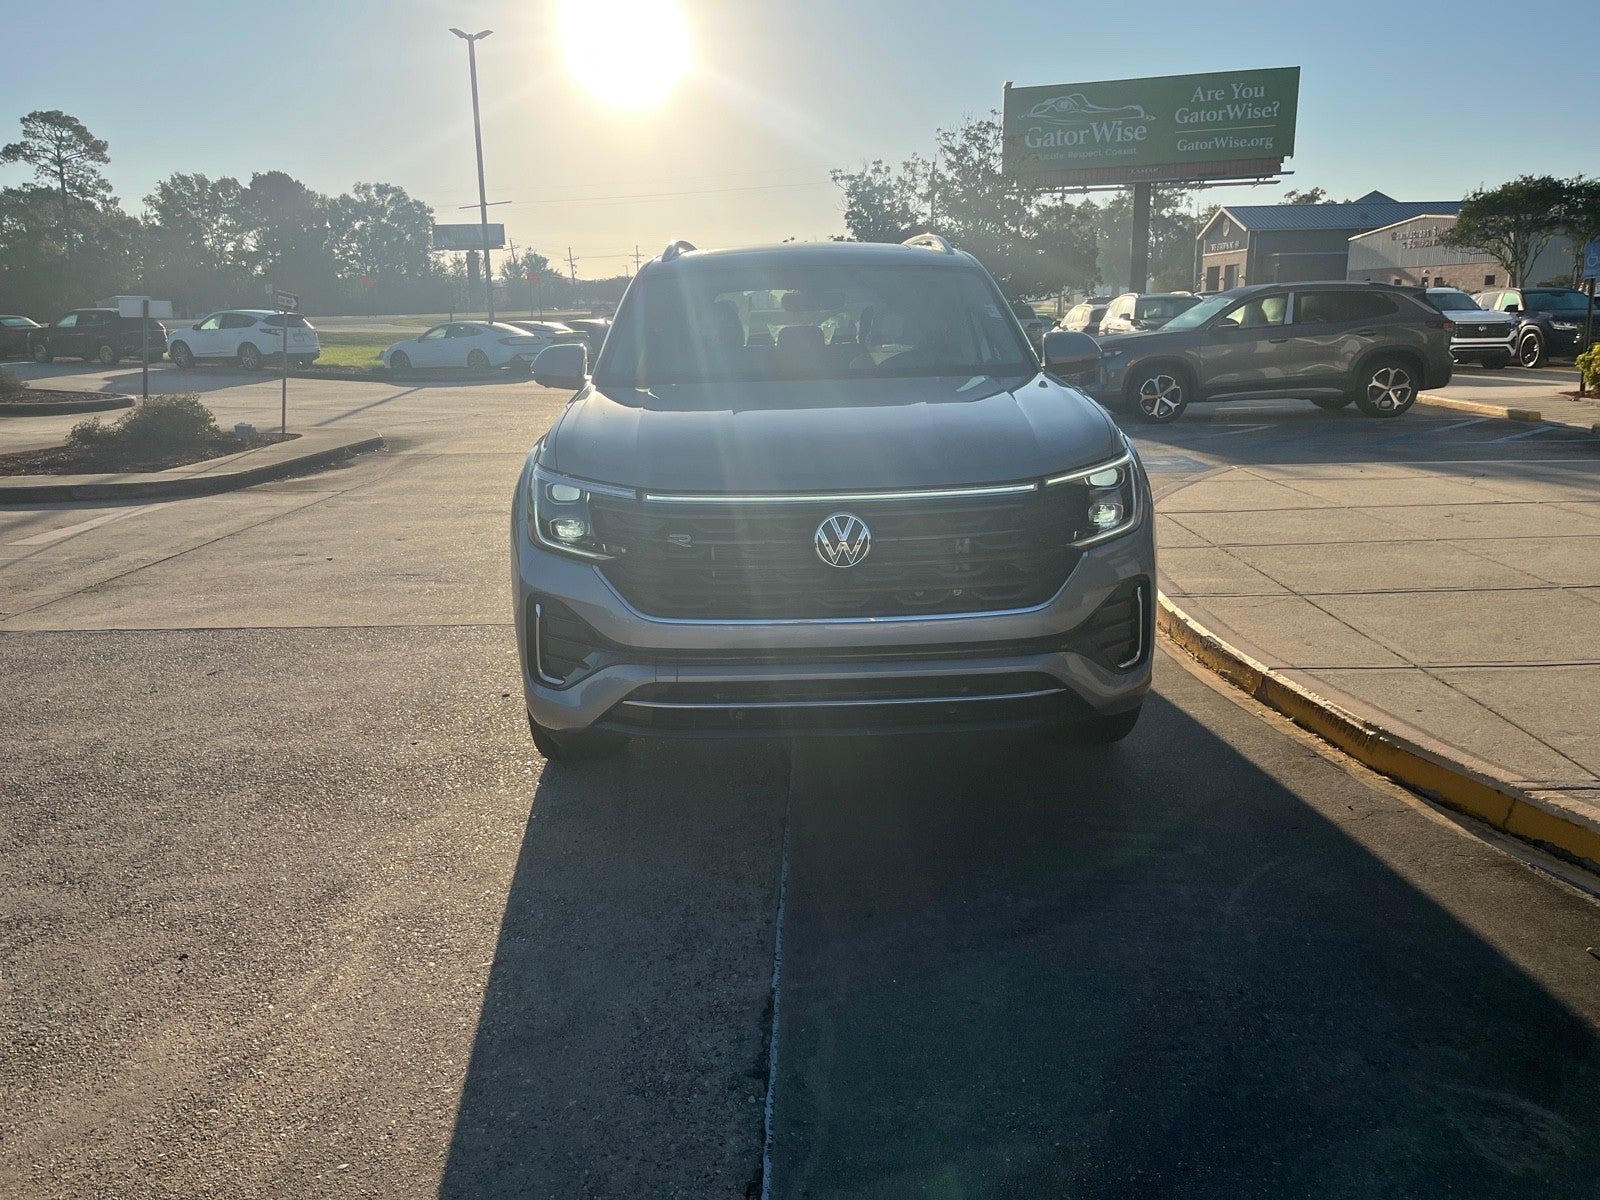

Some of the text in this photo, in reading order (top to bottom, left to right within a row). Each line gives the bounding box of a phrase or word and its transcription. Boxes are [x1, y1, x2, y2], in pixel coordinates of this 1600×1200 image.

[1191, 83, 1265, 102] Are You
[1174, 101, 1280, 124] GatorWise?
[1024, 120, 1147, 149] GatorWise
[1177, 136, 1274, 152] GatorWise.org
